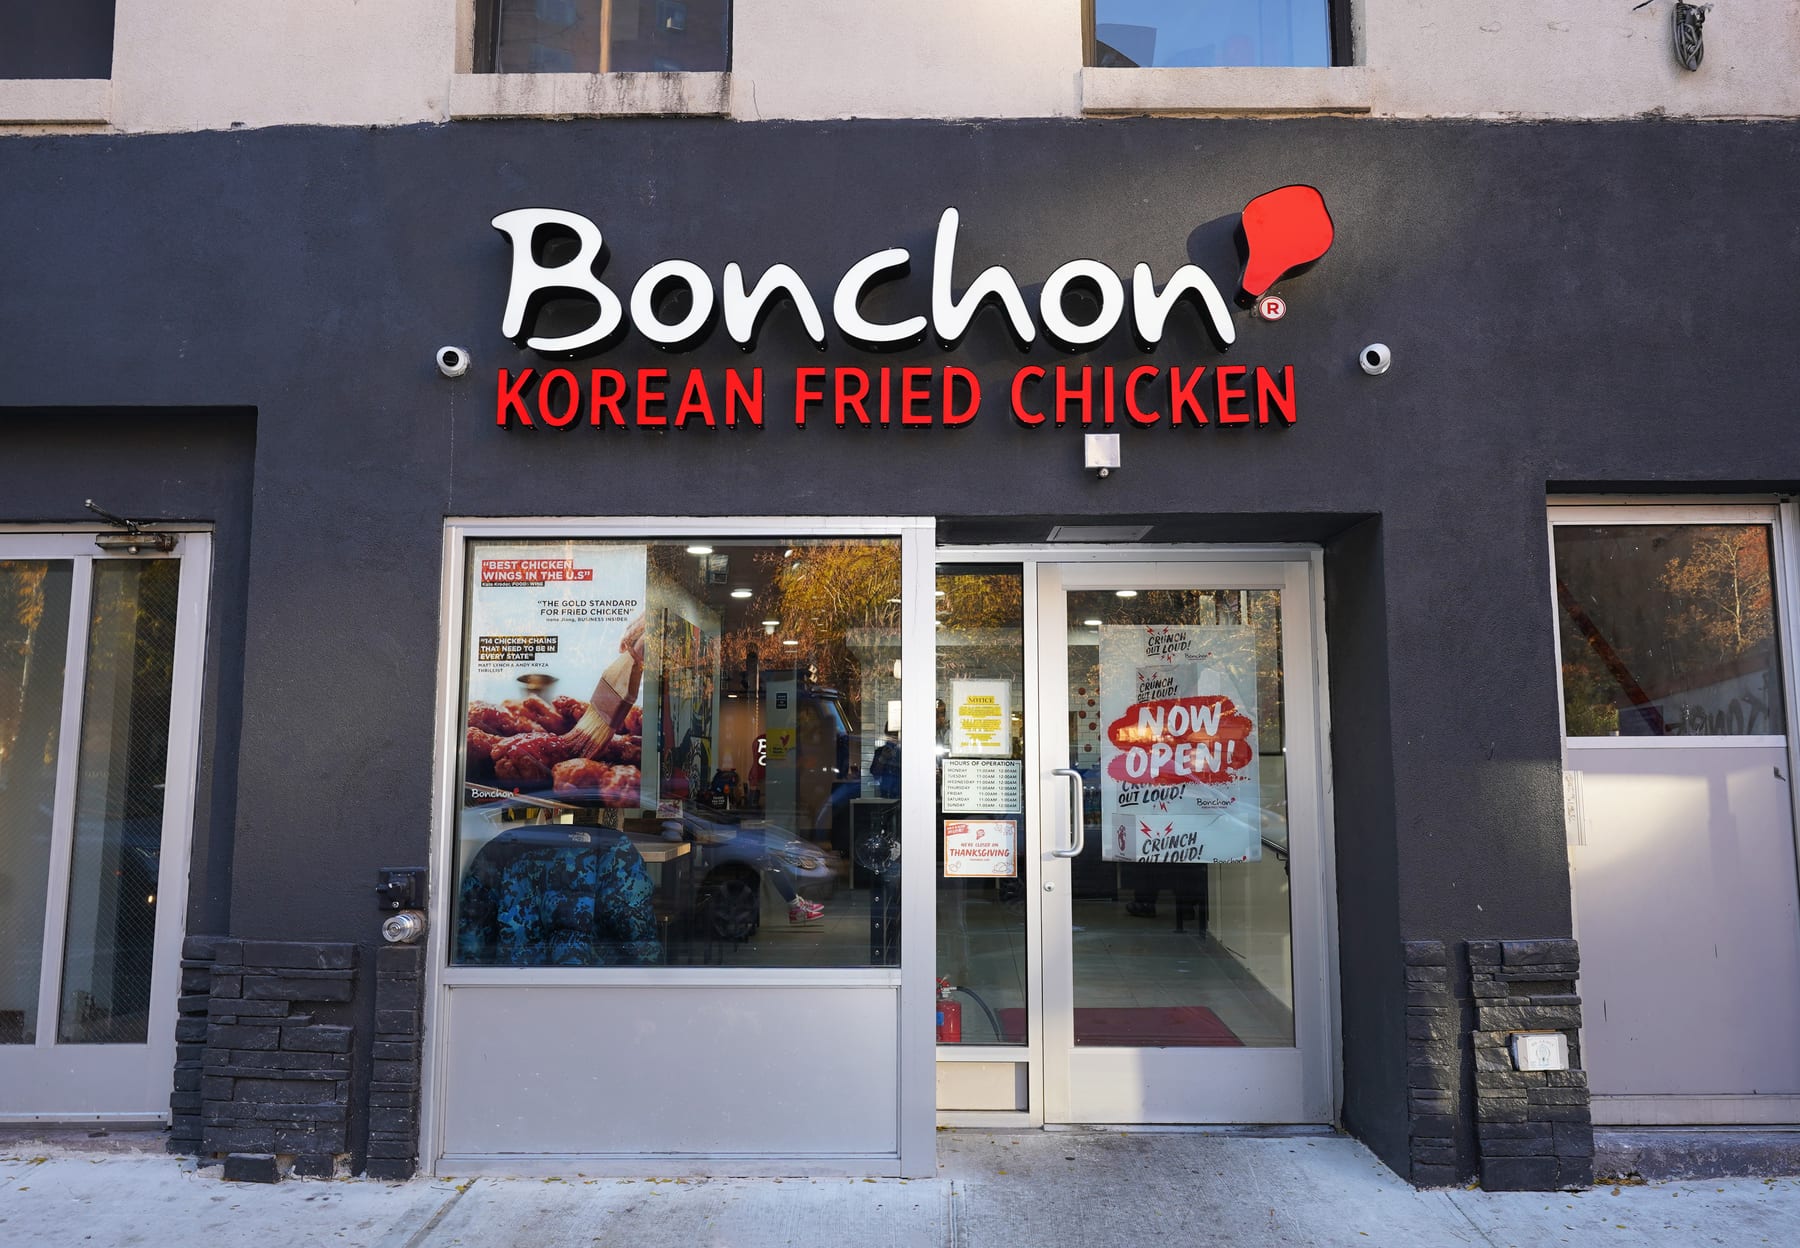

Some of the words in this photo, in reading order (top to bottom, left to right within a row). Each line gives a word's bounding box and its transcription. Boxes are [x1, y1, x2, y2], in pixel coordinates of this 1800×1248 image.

[491, 207, 1236, 351] Bonchon
[496, 367, 763, 426] KOREAN
[795, 366, 981, 425] FRIED
[1011, 365, 1297, 425] CHICKEN
[483, 561, 518, 569] "BEST
[521, 561, 572, 569] CHICKEN
[483, 571, 522, 580] WINGS
[525, 571, 537, 580] IN
[541, 571, 563, 580] THE
[589, 599, 638, 607] STANDARD
[1148, 632, 1187, 647] CRUNCH
[1146, 645, 1161, 656] OUT
[1162, 640, 1191, 654] LOUD!
[1139, 676, 1174, 693] CRUNCH
[1151, 685, 1178, 700] LOUD!
[1137, 701, 1222, 737] NOW
[1125, 739, 1236, 779] OPEN!
[471, 788, 514, 798] Bonchon
[1118, 791, 1140, 806] OUT
[1142, 784, 1186, 804] LOUD!
[1196, 797, 1231, 807] Bonchon
[1142, 832, 1198, 855] CRUNCH
[949, 848, 1010, 857] THANKSGIVING
[1164, 844, 1204, 863] LOUD!
